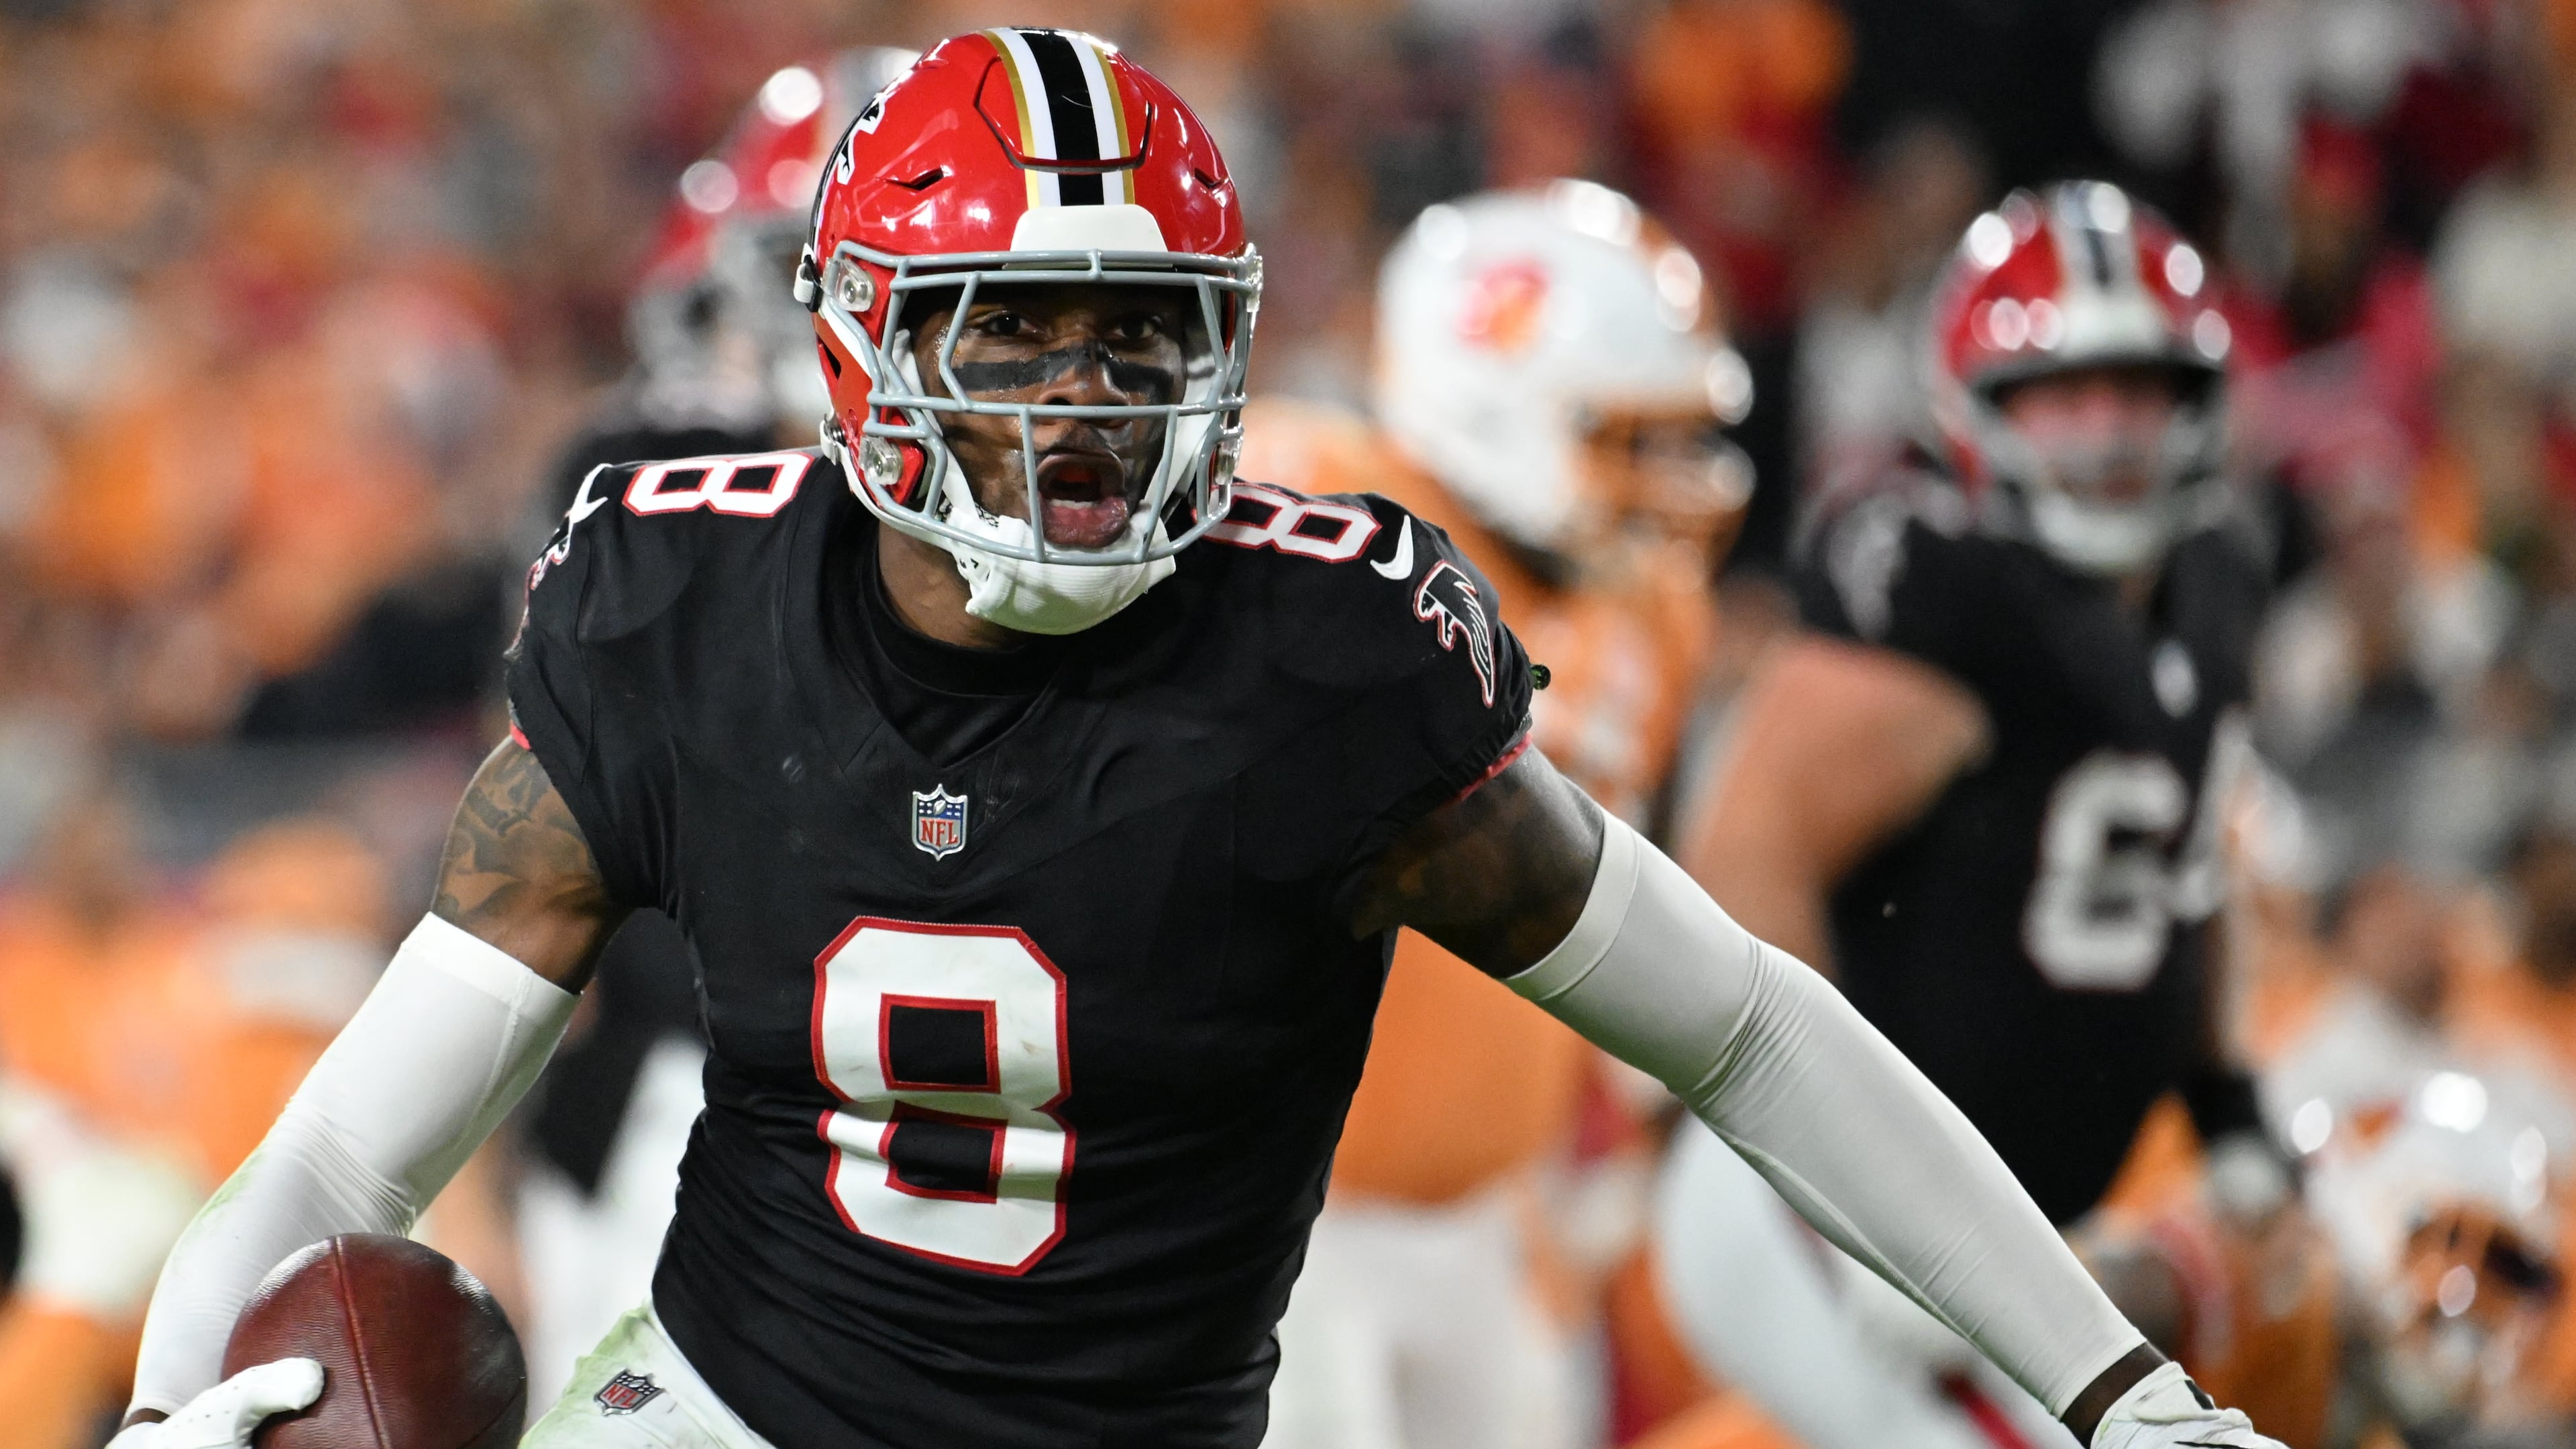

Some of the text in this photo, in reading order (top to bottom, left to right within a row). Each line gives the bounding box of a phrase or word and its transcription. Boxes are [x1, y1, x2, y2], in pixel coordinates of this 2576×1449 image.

[622, 451, 816, 519] 8
[920, 818, 959, 847] NFL
[810, 915, 1077, 1277] 8
[602, 1383, 639, 1408] NFL
